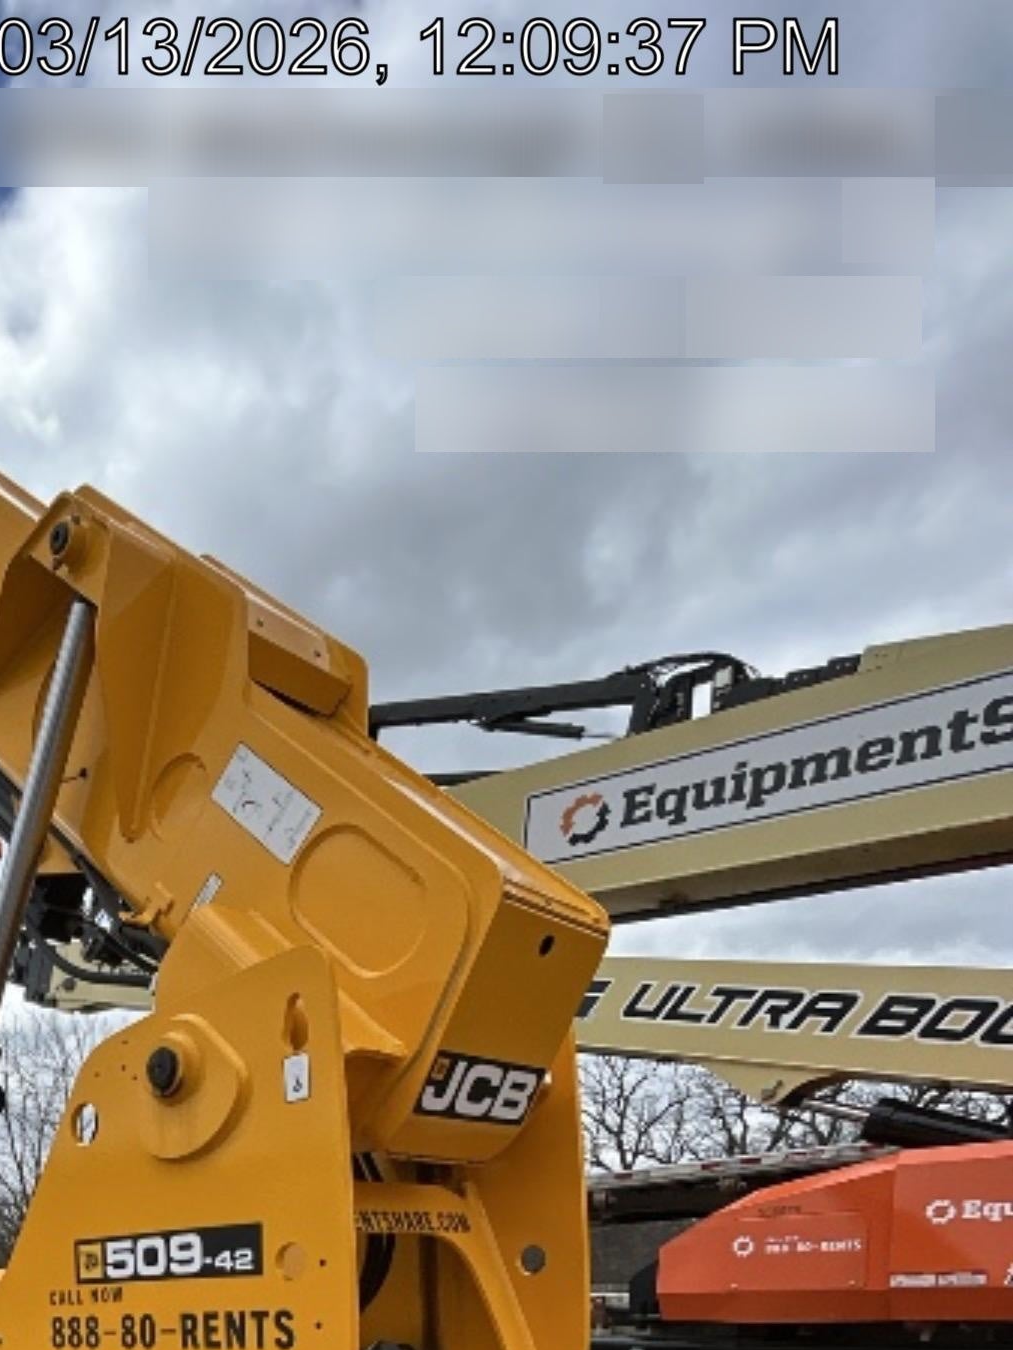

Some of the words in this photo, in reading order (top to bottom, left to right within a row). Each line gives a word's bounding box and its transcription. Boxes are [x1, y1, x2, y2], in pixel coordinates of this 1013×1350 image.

[620, 982, 862, 1036] ULTRA
[421, 1060, 538, 1121] JCB
[105, 1232, 255, 1279] 509-42
[49, 1288, 84, 1307] CALL
[91, 1285, 123, 1304] NOW
[51, 1310, 295, 1350] 888-80-RENTS
